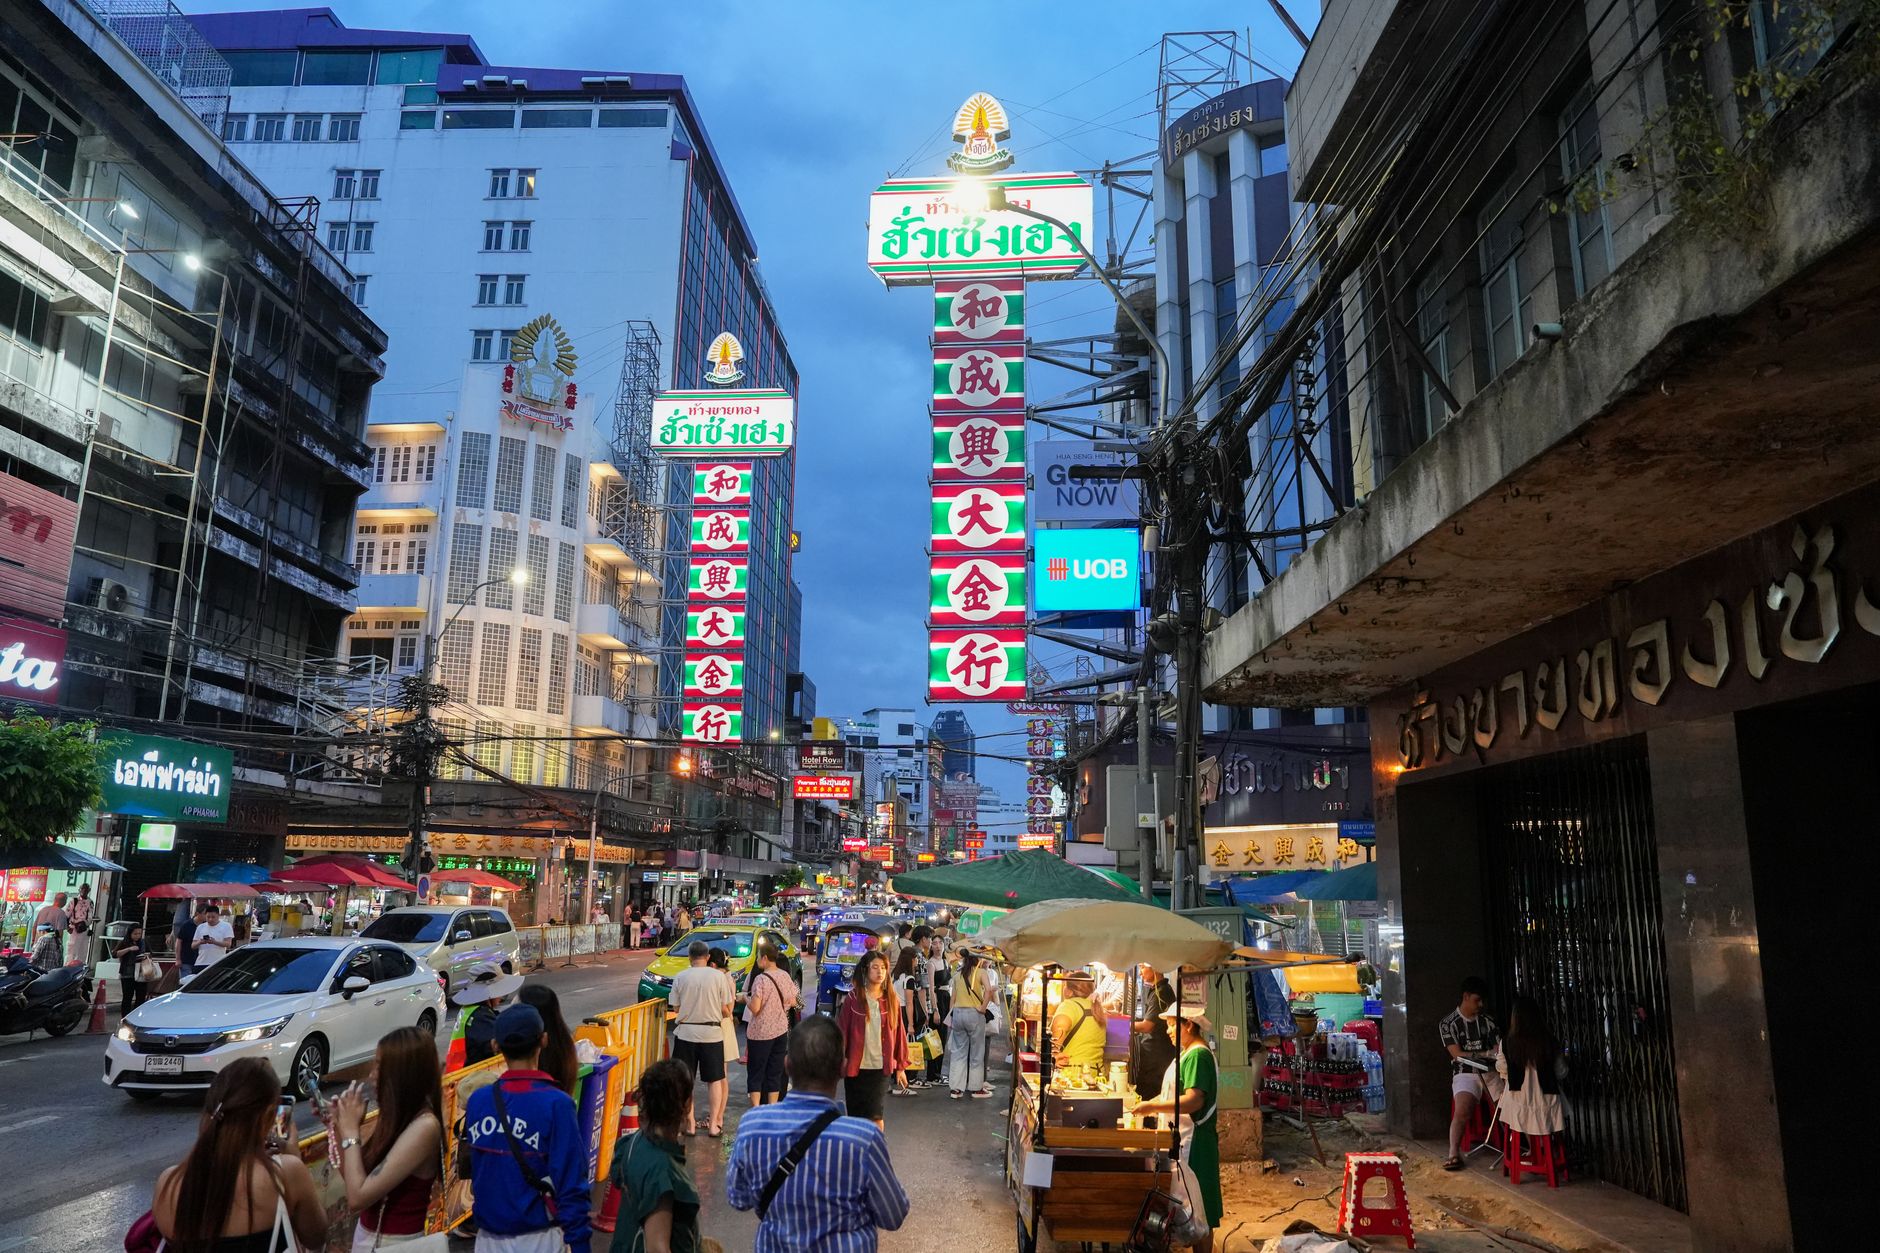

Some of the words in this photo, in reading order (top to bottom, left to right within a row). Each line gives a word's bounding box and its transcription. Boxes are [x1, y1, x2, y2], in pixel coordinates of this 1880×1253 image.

[688, 403, 760, 416] ห้างขายทอง
[1056, 486, 1117, 506] NOW
[1073, 558, 1128, 579] UOB
[801, 756, 821, 764] Hotel
[822, 756, 843, 764] Royal
[183, 806, 192, 816] AP
[193, 807, 220, 818] PHARMA
